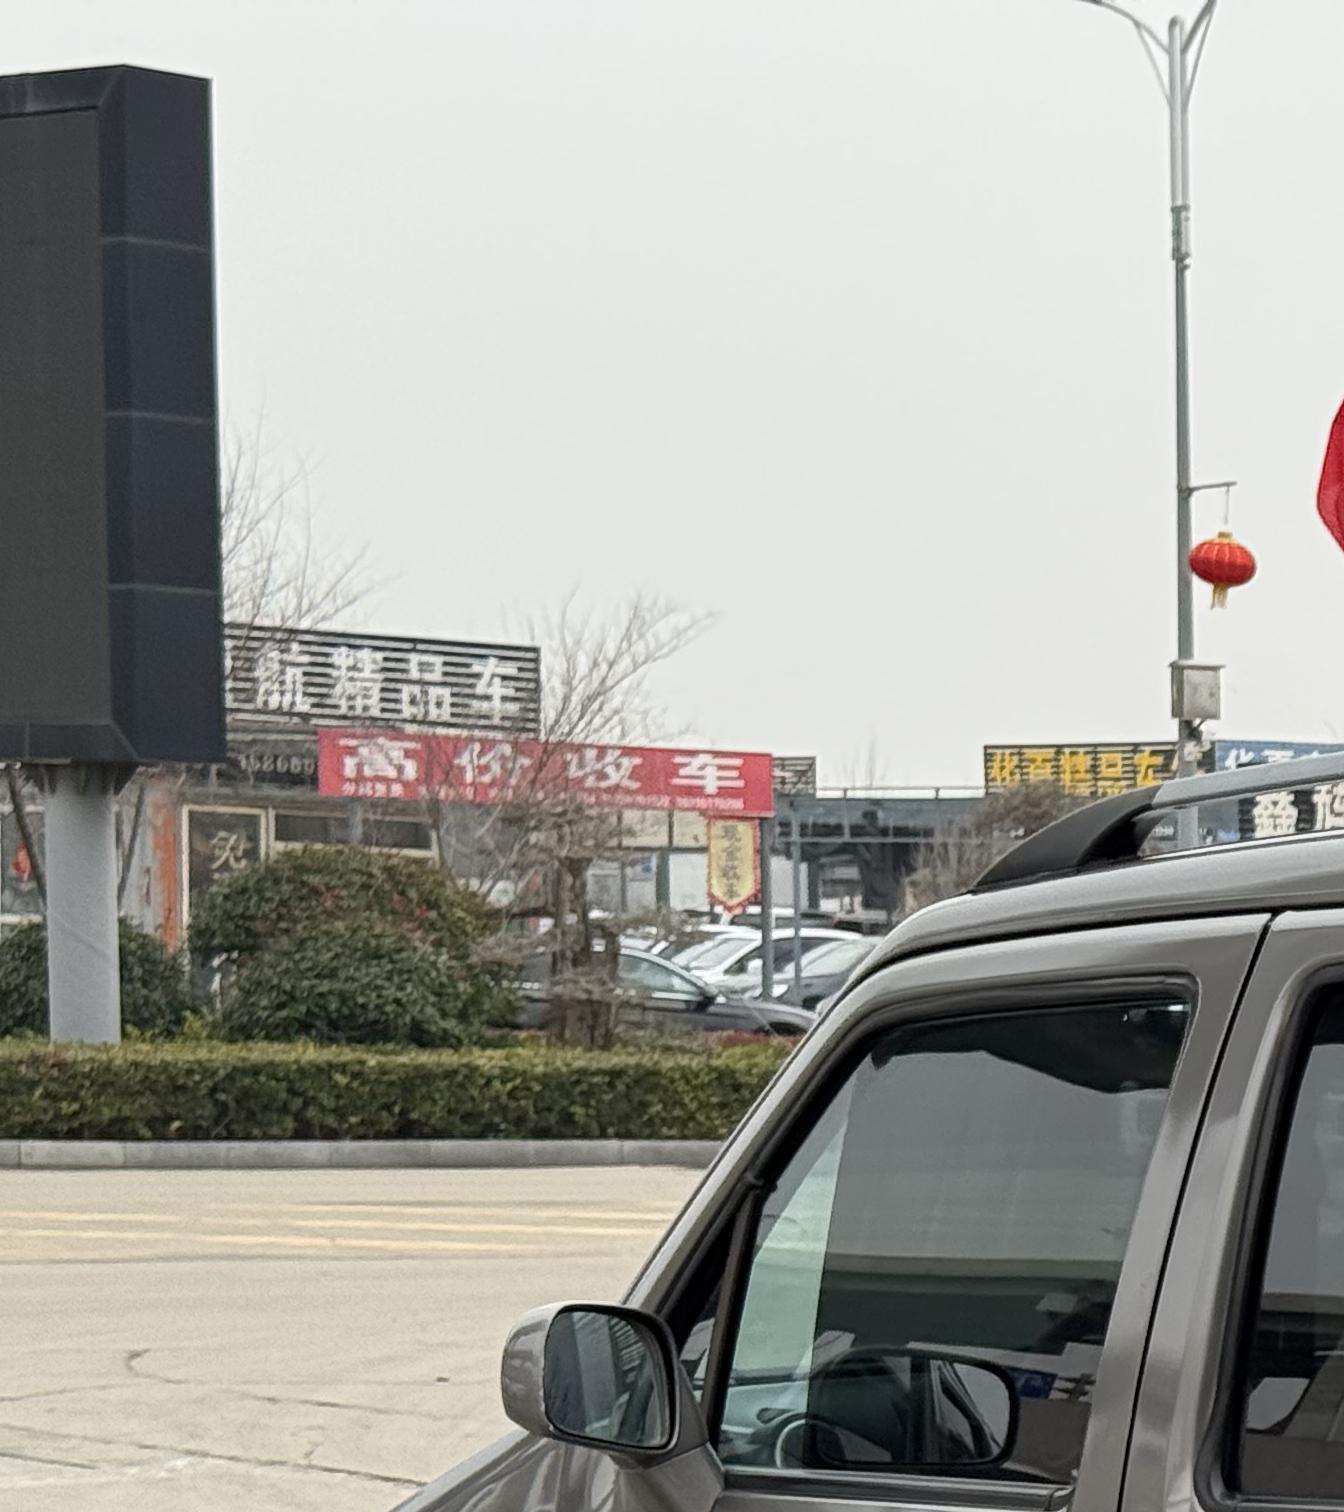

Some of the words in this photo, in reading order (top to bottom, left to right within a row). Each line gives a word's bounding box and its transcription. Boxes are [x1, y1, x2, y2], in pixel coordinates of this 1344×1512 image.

[223, 640, 522, 726] 航精品车
[339, 737, 746, 796] 高价收车
